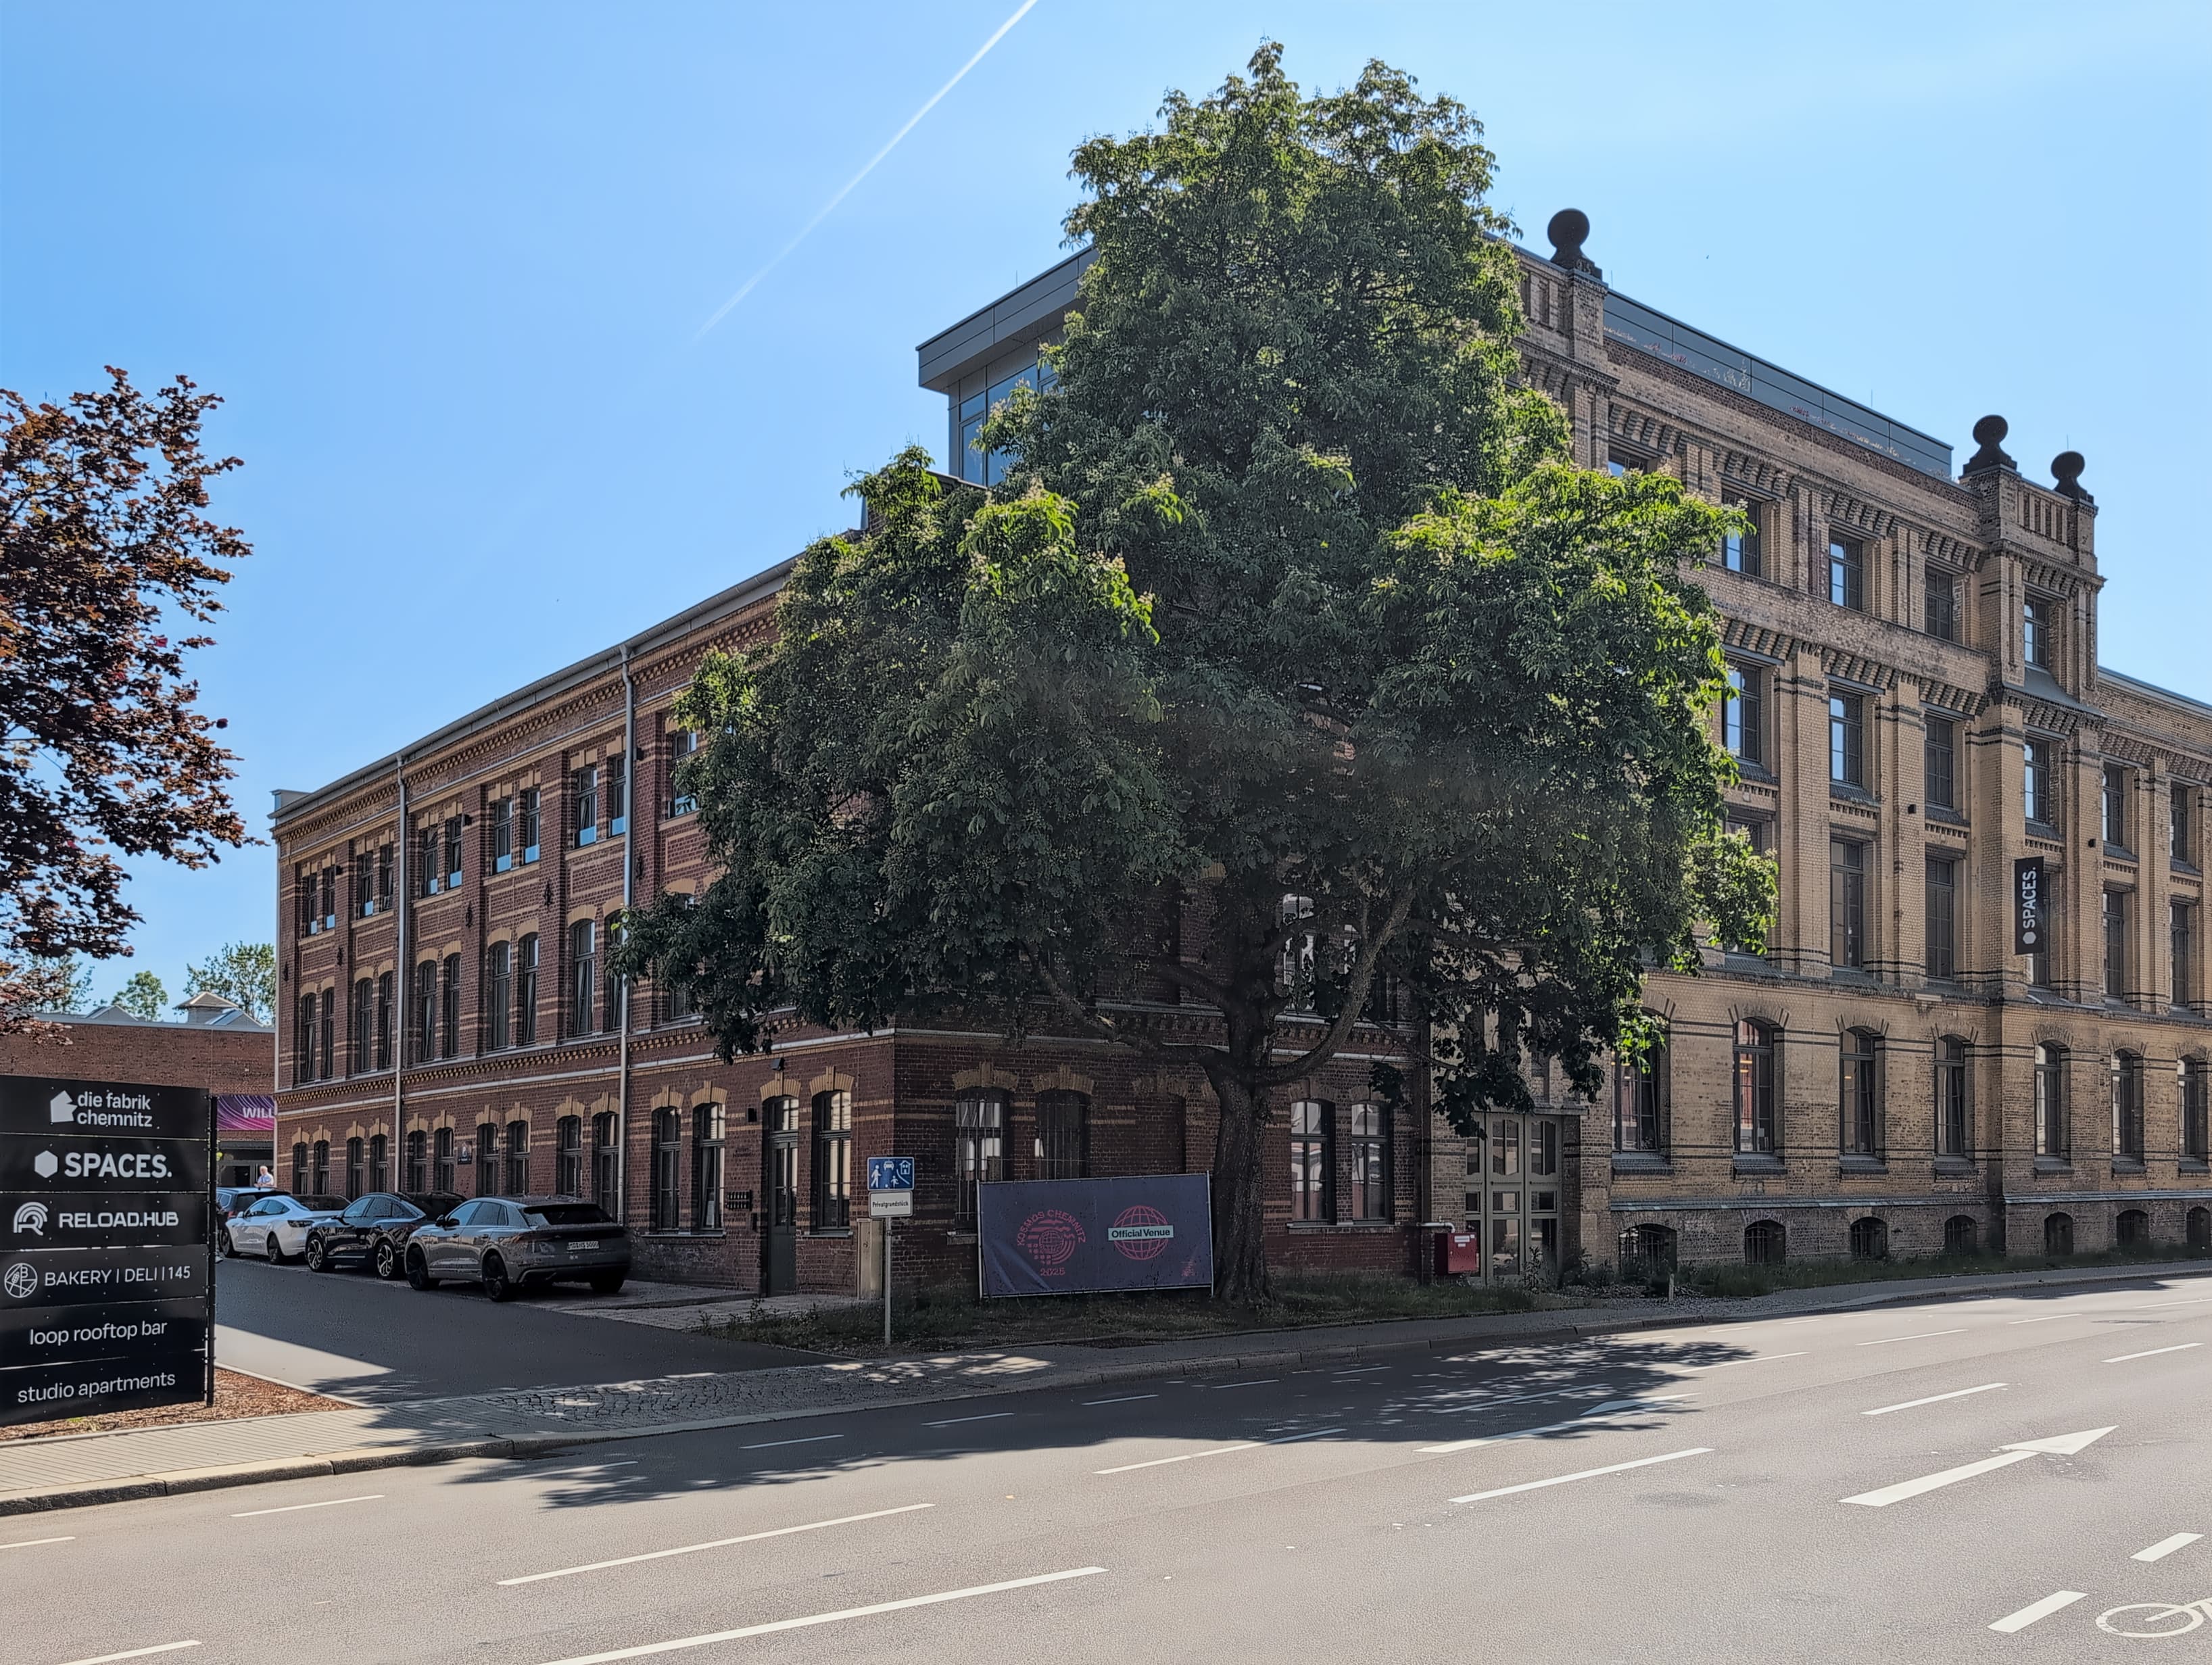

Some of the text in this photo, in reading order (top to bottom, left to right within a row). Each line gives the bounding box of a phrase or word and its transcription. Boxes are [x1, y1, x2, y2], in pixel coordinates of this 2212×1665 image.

[2021, 867, 2037, 929] SPACES.
[77, 1090, 151, 1110] die fabrik
[77, 1109, 153, 1128] chemnitz
[64, 1152, 172, 1178] SPACES.
[871, 1200, 909, 1209] Privatgrundstück
[59, 1211, 179, 1228] RELOAD.HUB
[1016, 1209, 1086, 1246] KOSMOS CHEMNITZ
[1111, 1228, 1171, 1238] Official Venue
[44, 1269, 112, 1286] BAKERY
[124, 1267, 158, 1282] DELI
[168, 1265, 191, 1280] 145
[30, 1320, 168, 1346] loop rooftop bar
[18, 1372, 176, 1403] studio apartments
